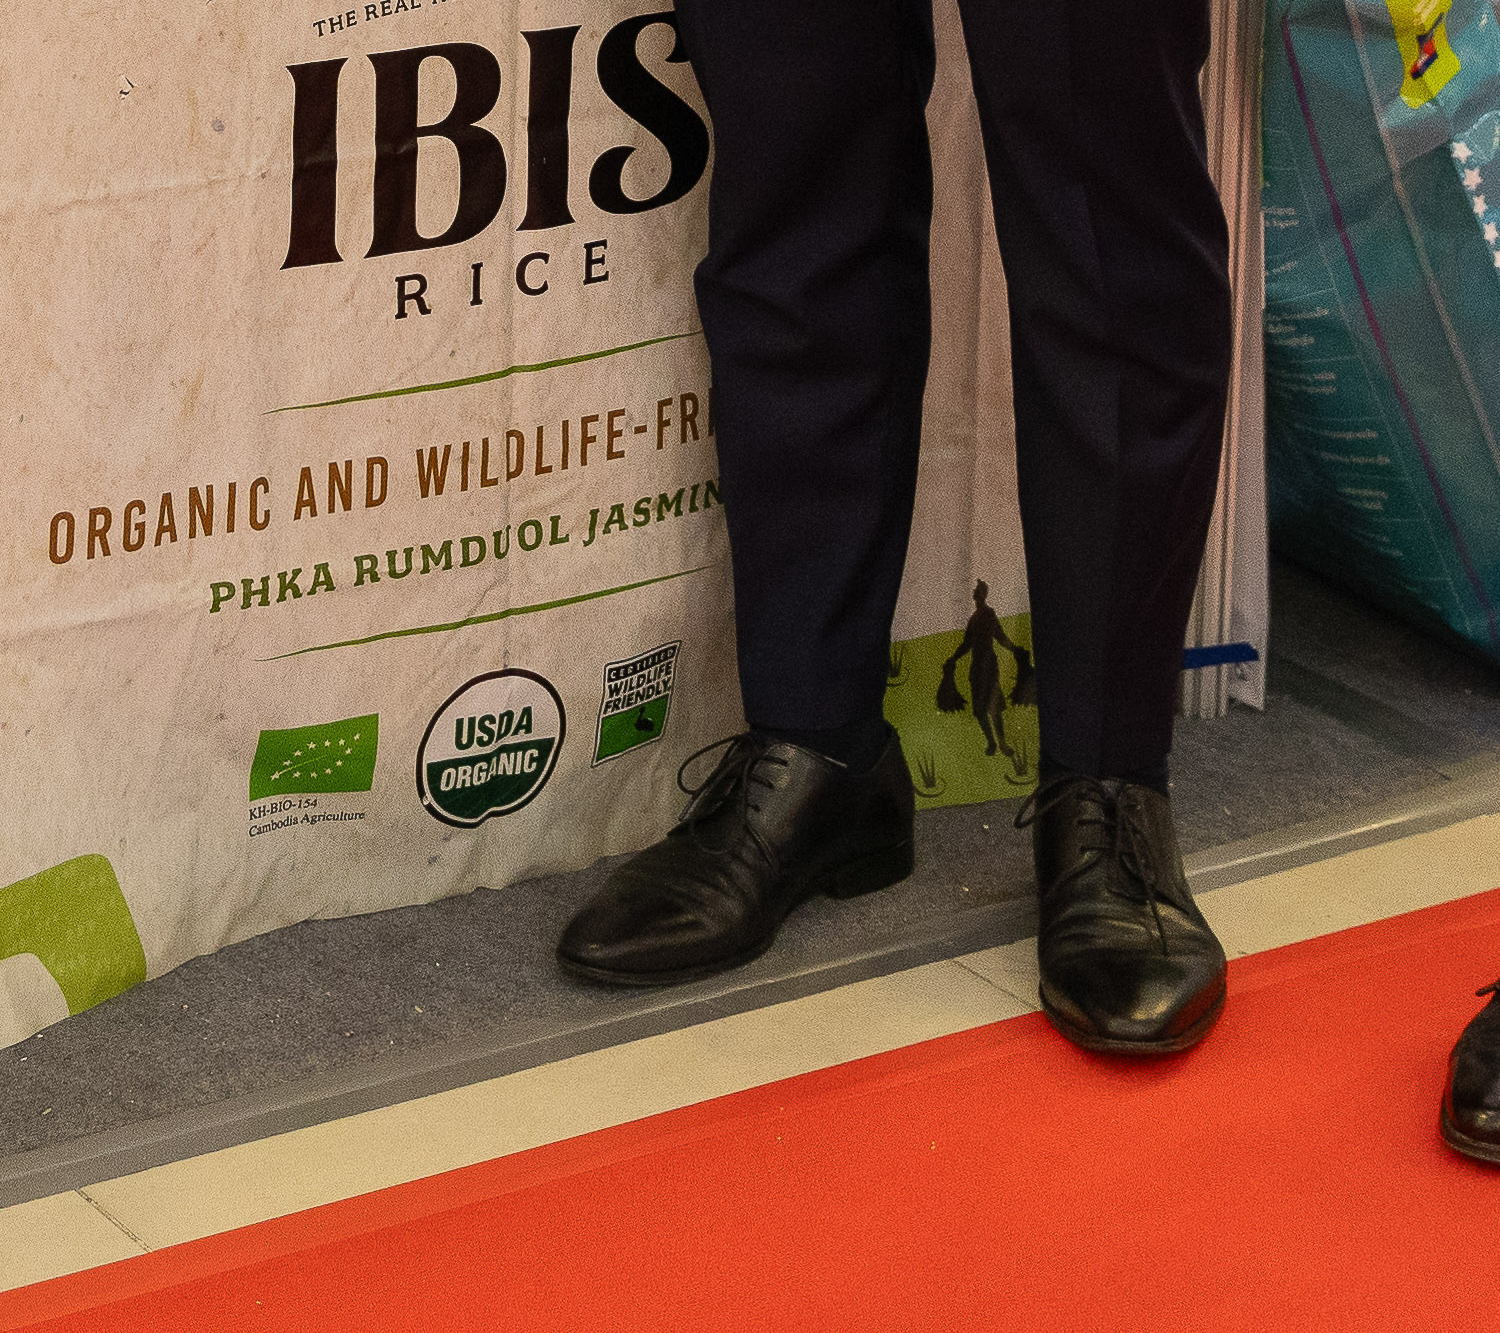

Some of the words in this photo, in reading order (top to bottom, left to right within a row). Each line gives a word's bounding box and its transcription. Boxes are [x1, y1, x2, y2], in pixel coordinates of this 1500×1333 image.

[312, 9, 359, 38] THE
[280, 10, 711, 271] IBIS
[394, 238, 611, 321] RICE
[48, 476, 272, 566] ORGANIC
[293, 455, 390, 523] AND
[416, 387, 718, 500] WILDLIFE-FR
[209, 561, 337, 616] PHKA
[353, 514, 571, 588] RUMDUOL
[583, 475, 727, 549] JASMIN
[606, 662, 673, 699] WILDLIFE
[608, 646, 676, 680] CERTIFIED
[454, 705, 533, 751] USDA
[439, 747, 539, 793] ORGANIC
[248, 797, 318, 821] KH-BIO-154
[248, 815, 299, 838] Cambodia
[300, 809, 366, 827] Agriculture
